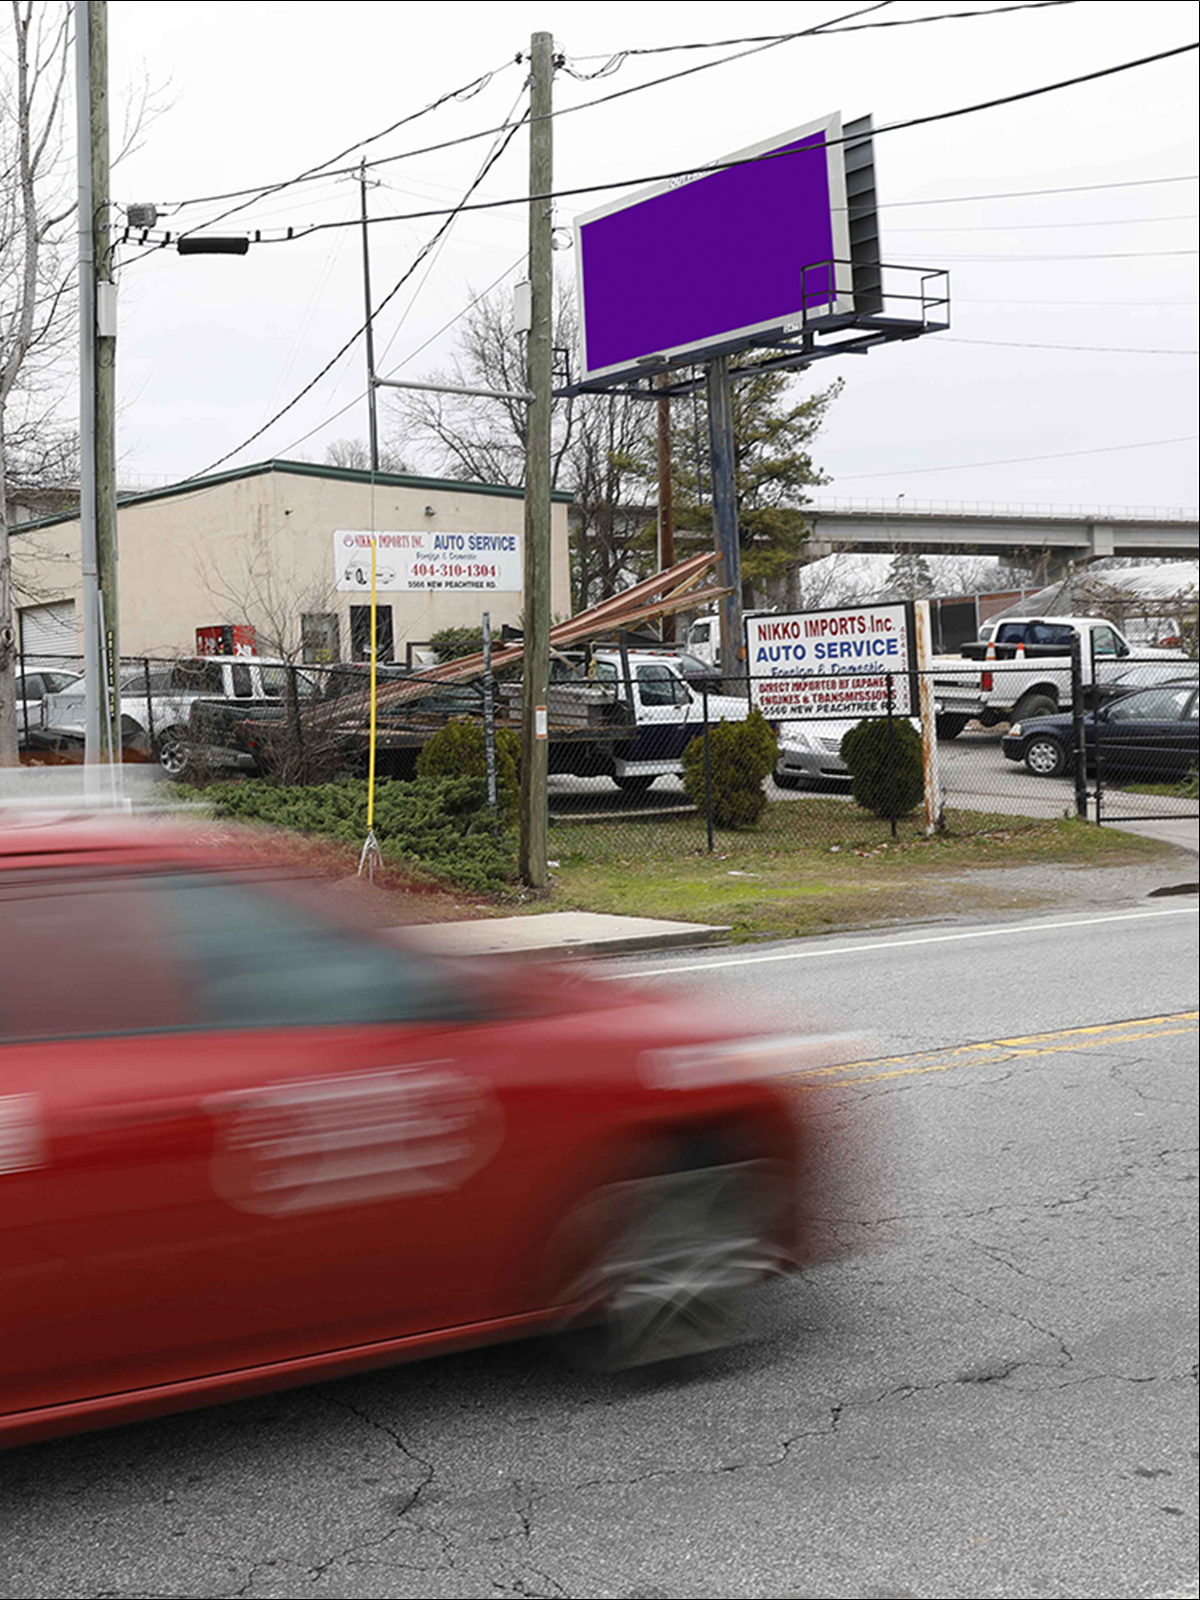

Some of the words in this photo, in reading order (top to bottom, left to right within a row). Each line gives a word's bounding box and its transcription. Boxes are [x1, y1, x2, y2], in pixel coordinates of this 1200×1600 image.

[379, 535, 410, 548] IMPORTS
[434, 535, 464, 551] AUTO
[468, 536, 516, 551] SERVICE
[411, 563, 496, 577] 404-310-1304
[445, 581, 484, 589] PEACHTREE
[757, 621, 800, 642] NIKKO
[756, 645, 807, 663] AUTO
[814, 638, 899, 660] SERVICE
[759, 682, 790, 693] DIRECT
[791, 679, 837, 692] IMPORTED
[759, 694, 801, 706] ENGINES
[812, 689, 897, 703] TRANSMISSIONS
[790, 705, 813, 714] NEW
[816, 702, 877, 713] PEACHTREE
